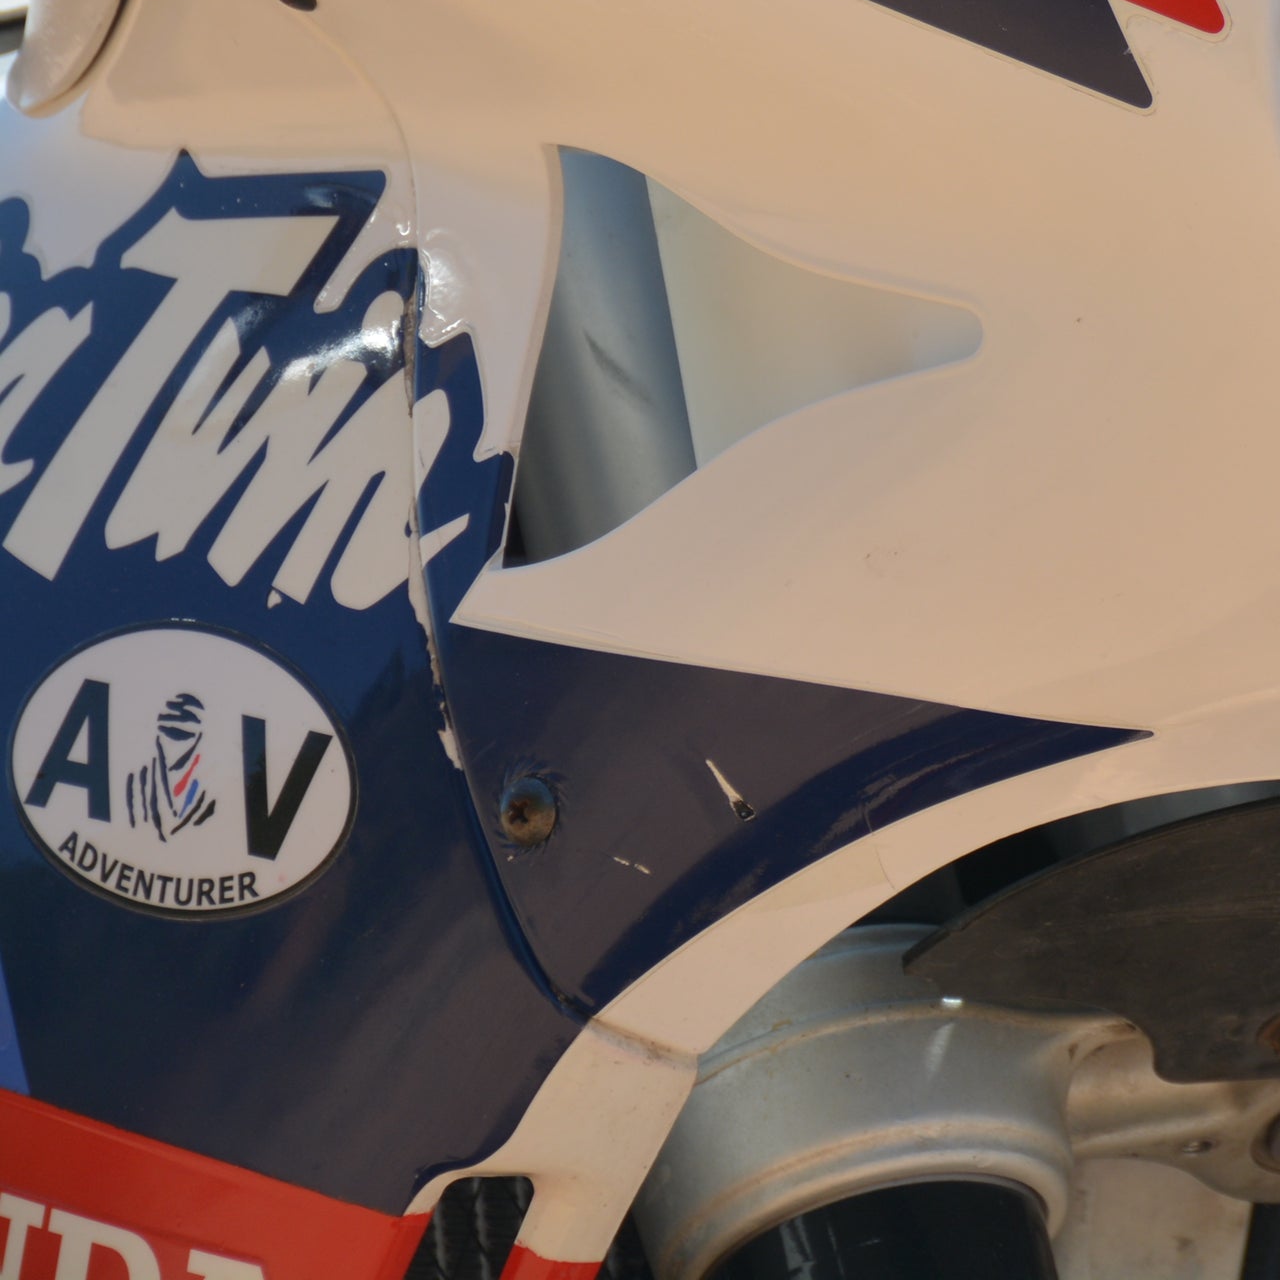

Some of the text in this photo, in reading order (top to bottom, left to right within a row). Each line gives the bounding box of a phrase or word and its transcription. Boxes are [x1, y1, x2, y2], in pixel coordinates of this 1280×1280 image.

[3, 214, 470, 611] Twin
[24, 678, 334, 861] A V
[58, 830, 260, 907] ADVENTURER
